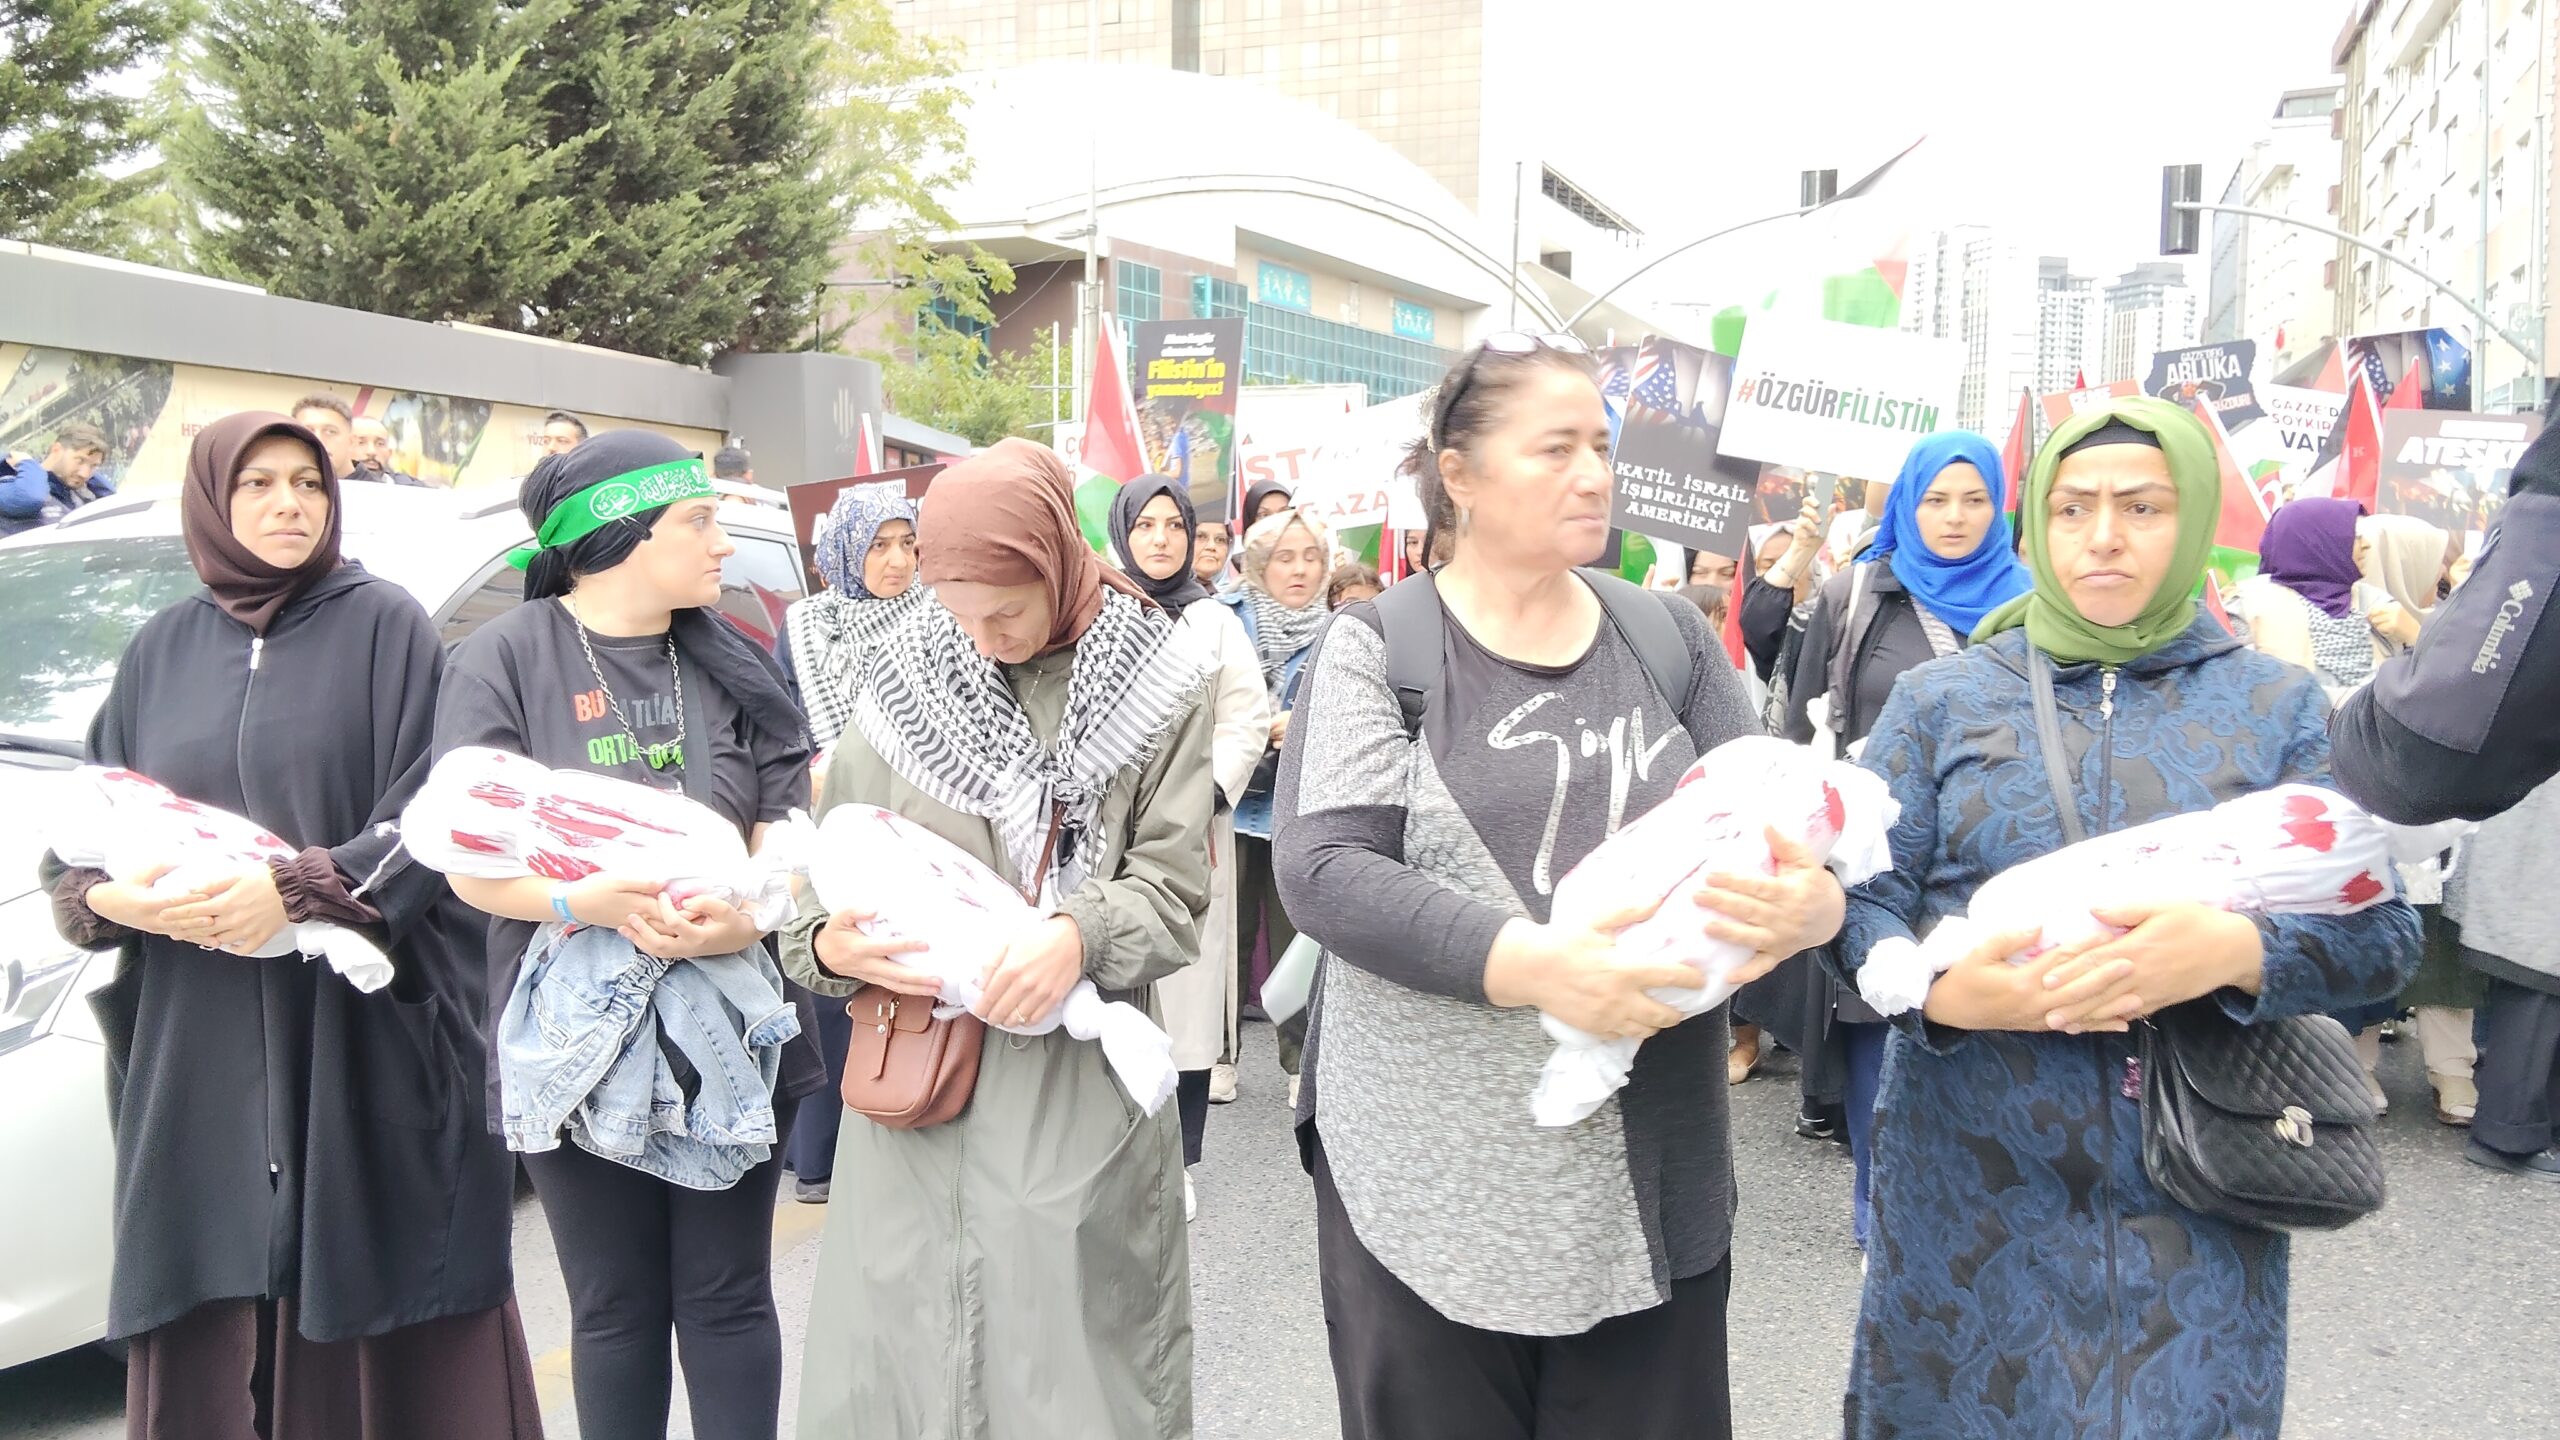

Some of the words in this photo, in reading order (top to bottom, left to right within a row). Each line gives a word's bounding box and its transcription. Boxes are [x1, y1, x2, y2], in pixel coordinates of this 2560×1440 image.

[2166, 354, 2242, 386] ABLUKA
[1736, 371, 1940, 434] #ÖZGÜRFİLİSTİN
[1615, 462, 1676, 487] KATİL
[1683, 473, 1750, 503] İSRAİL
[1620, 478, 1731, 518] İŞBİRLİKÇİ
[1625, 501, 1725, 534] AMERİKA!
[2471, 599, 2523, 674] Columbia
[574, 689, 606, 722] BU
